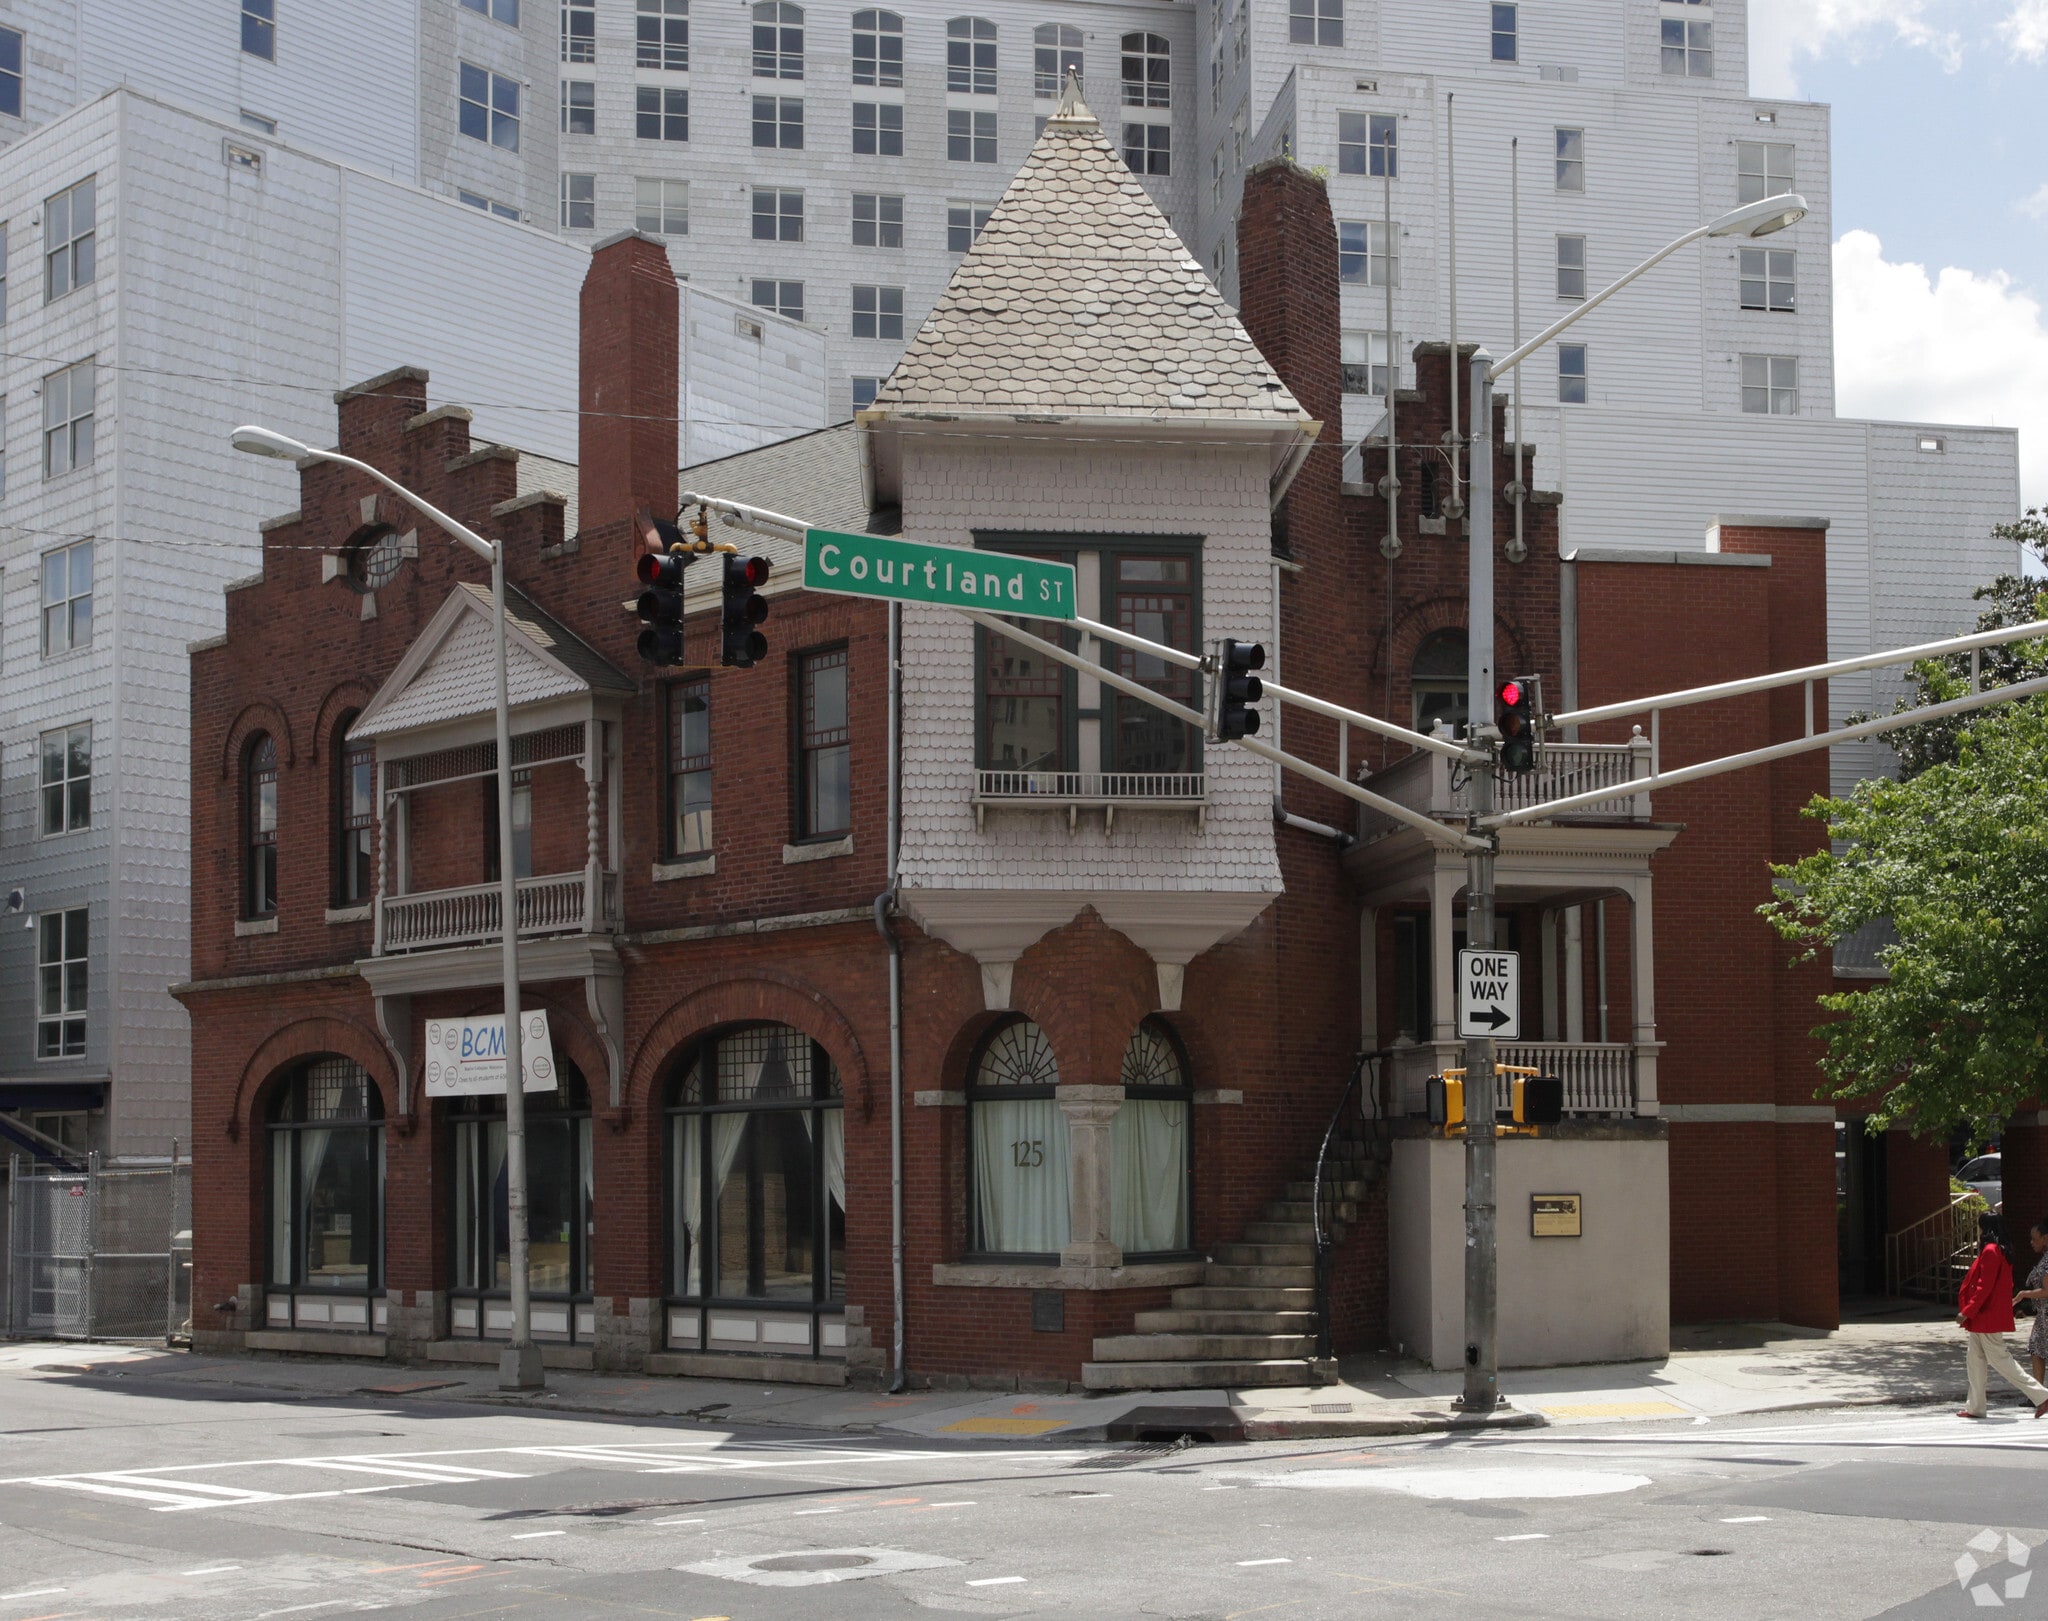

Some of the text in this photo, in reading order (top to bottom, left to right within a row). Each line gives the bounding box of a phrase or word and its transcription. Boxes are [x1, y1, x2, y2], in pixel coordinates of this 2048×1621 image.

[818, 544, 1063, 602] Courtland ST
[1470, 957, 1509, 978] ONE
[1470, 981, 1509, 1001] WAY
[461, 1026, 506, 1057] BCM
[1010, 1140, 1044, 1168] 125
